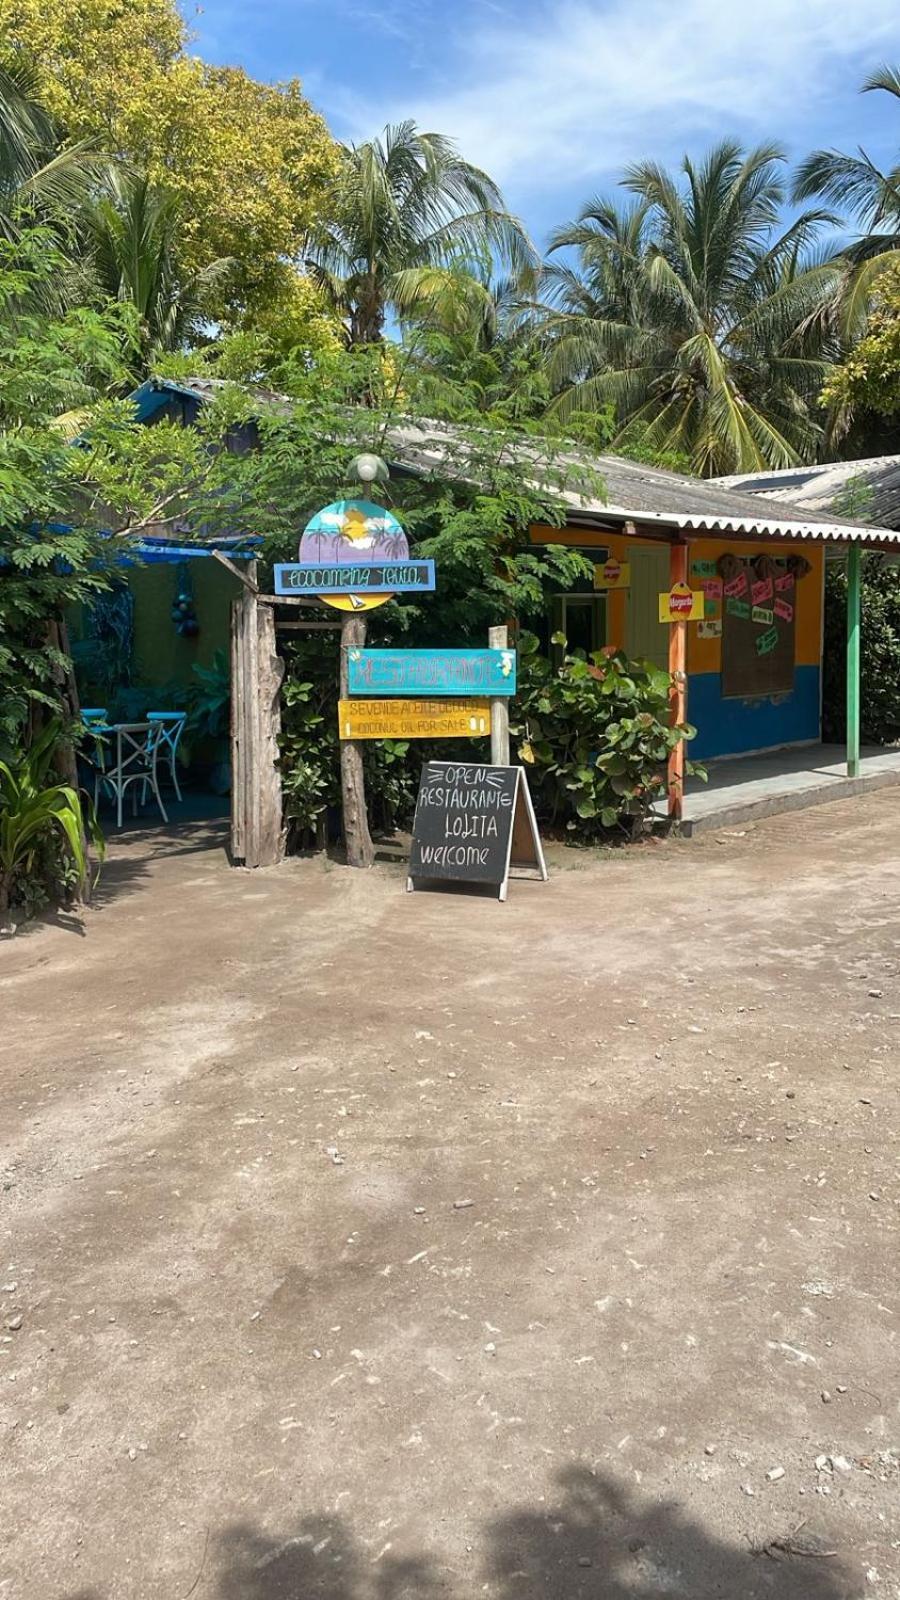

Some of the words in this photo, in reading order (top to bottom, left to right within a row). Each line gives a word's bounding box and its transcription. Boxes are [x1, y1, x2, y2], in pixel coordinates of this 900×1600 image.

[354, 655, 505, 687] RESTAURANTE
[401, 720, 415, 733] OIL
[417, 720, 437, 733] FOR
[439, 718, 468, 731] SALE
[445, 766, 487, 786] OPEN
[420, 787, 512, 810] RESTAURANTE
[445, 813, 498, 838] LOLITA
